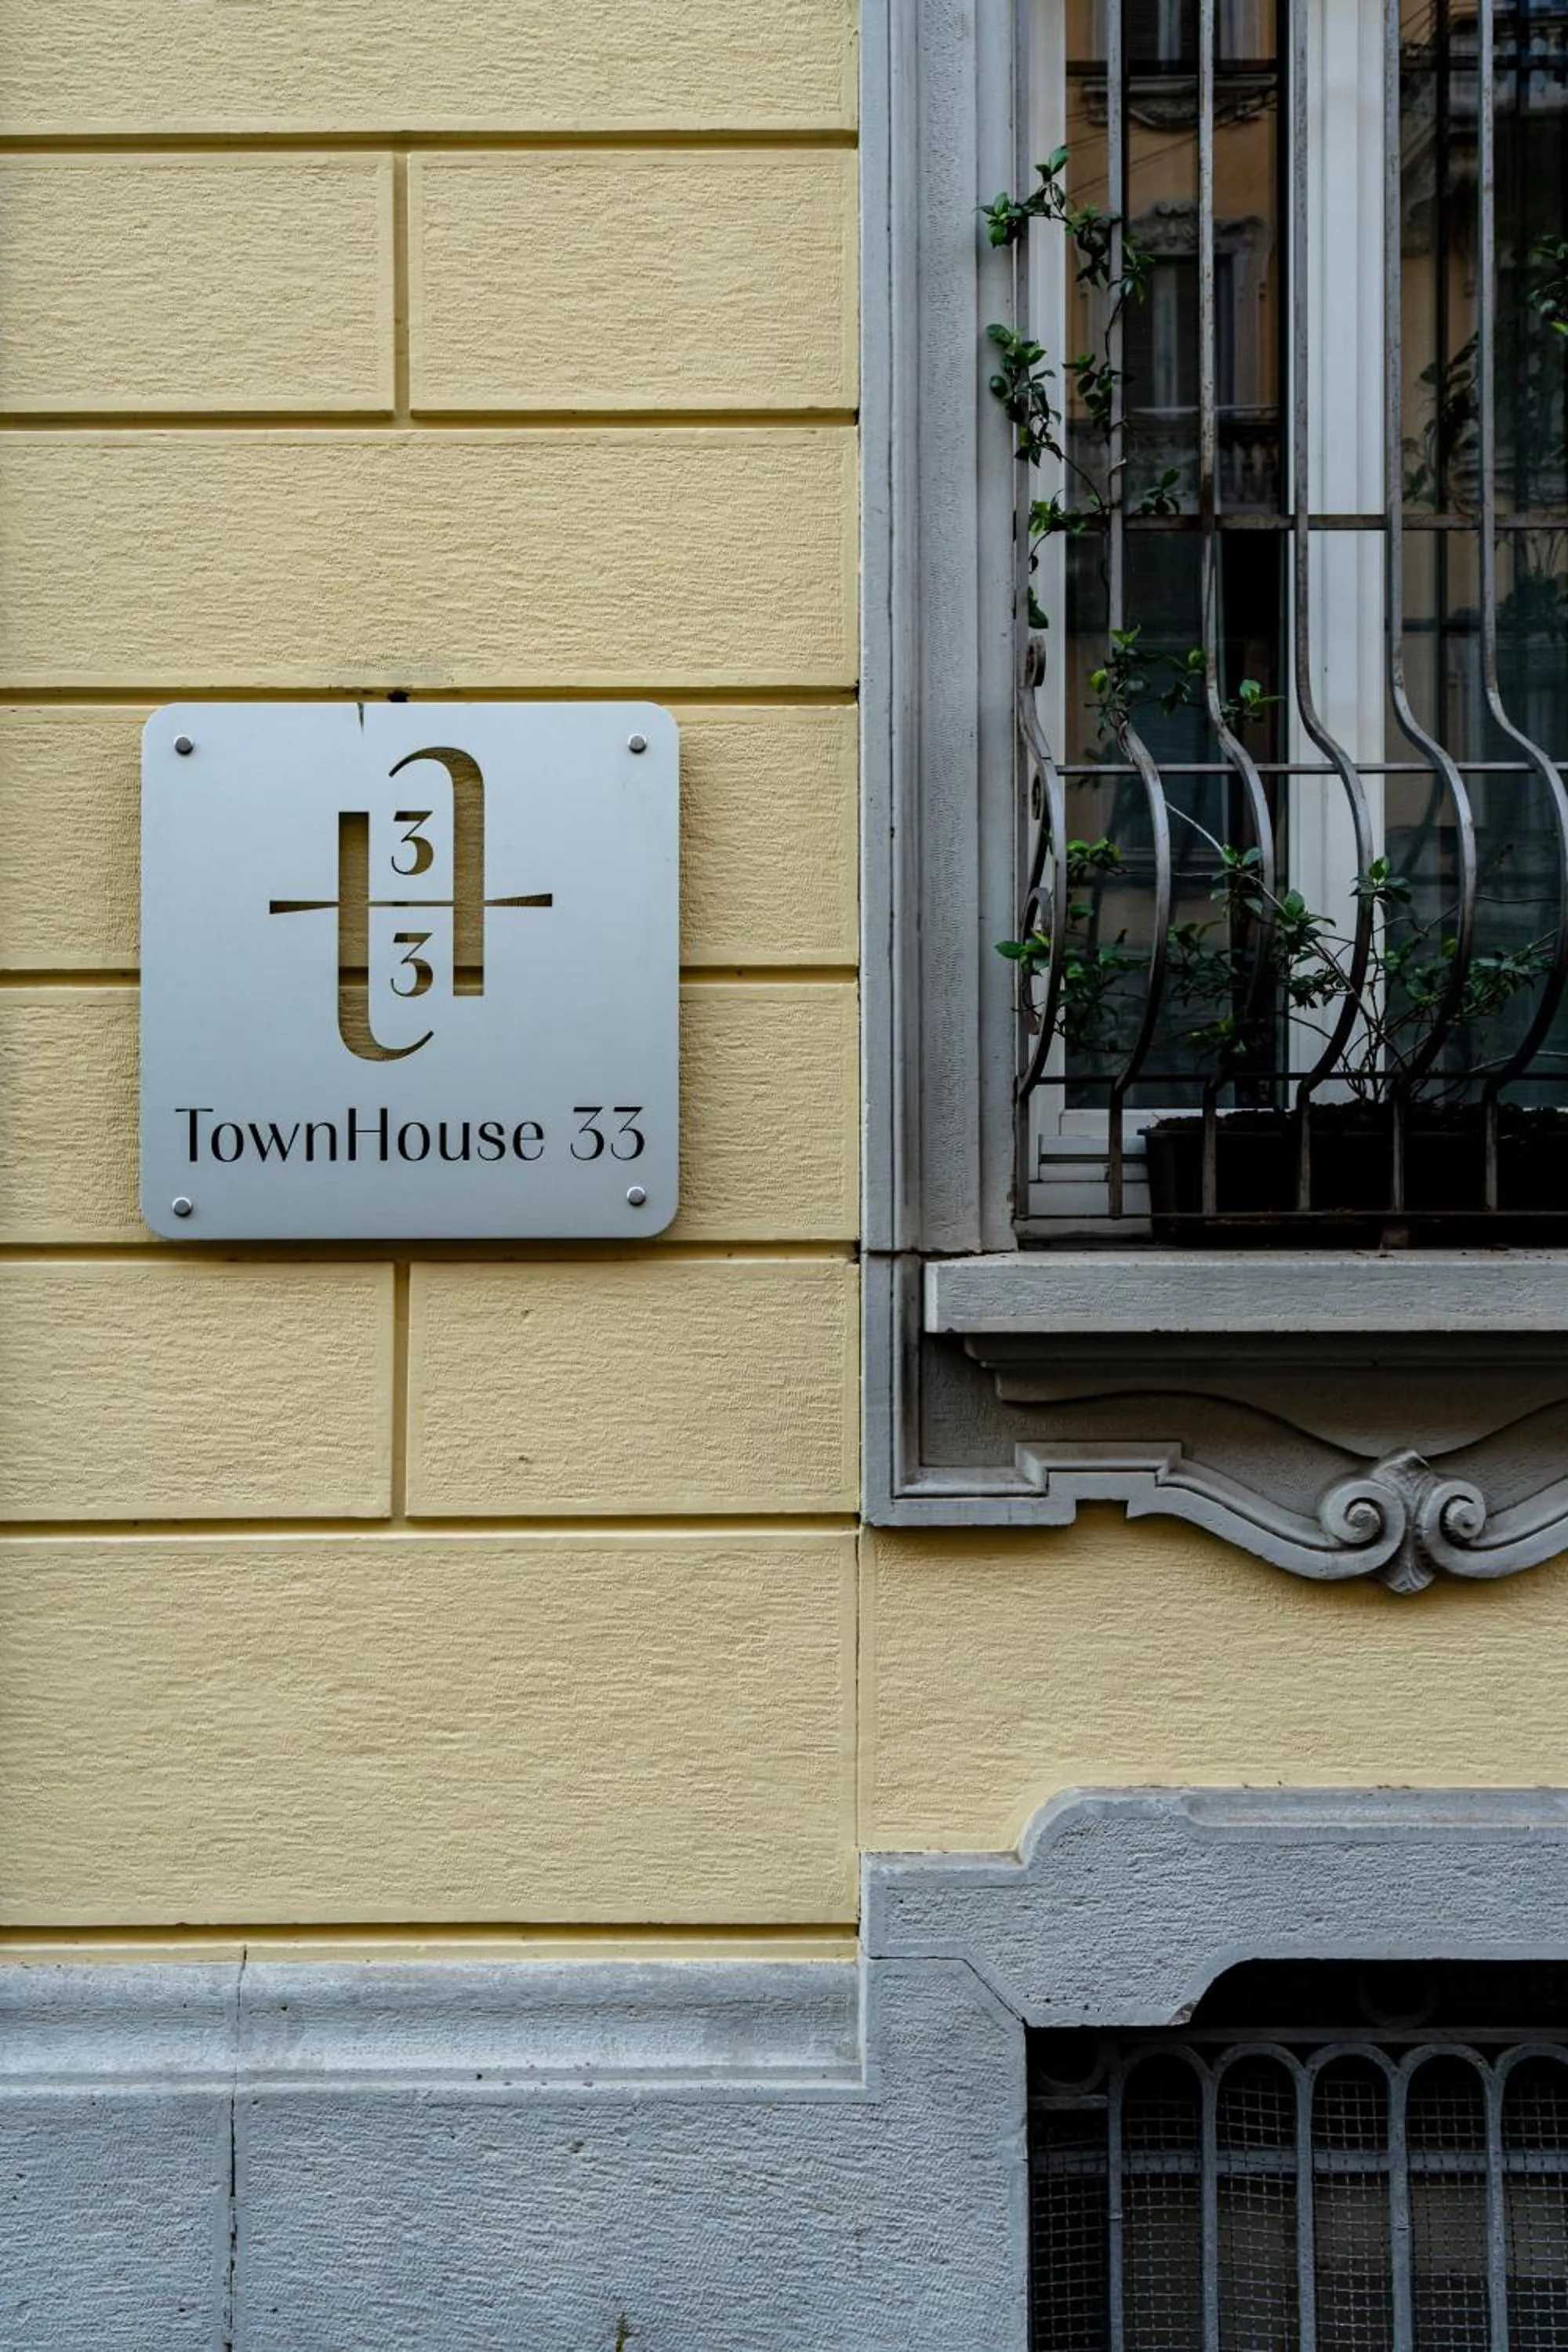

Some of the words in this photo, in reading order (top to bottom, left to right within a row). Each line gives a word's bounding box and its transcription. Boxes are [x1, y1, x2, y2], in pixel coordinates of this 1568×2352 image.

[391, 810, 434, 876] 3
[390, 932, 434, 997] 3
[175, 1107, 544, 1163] TownHouse
[570, 1106, 645, 1161] 33
